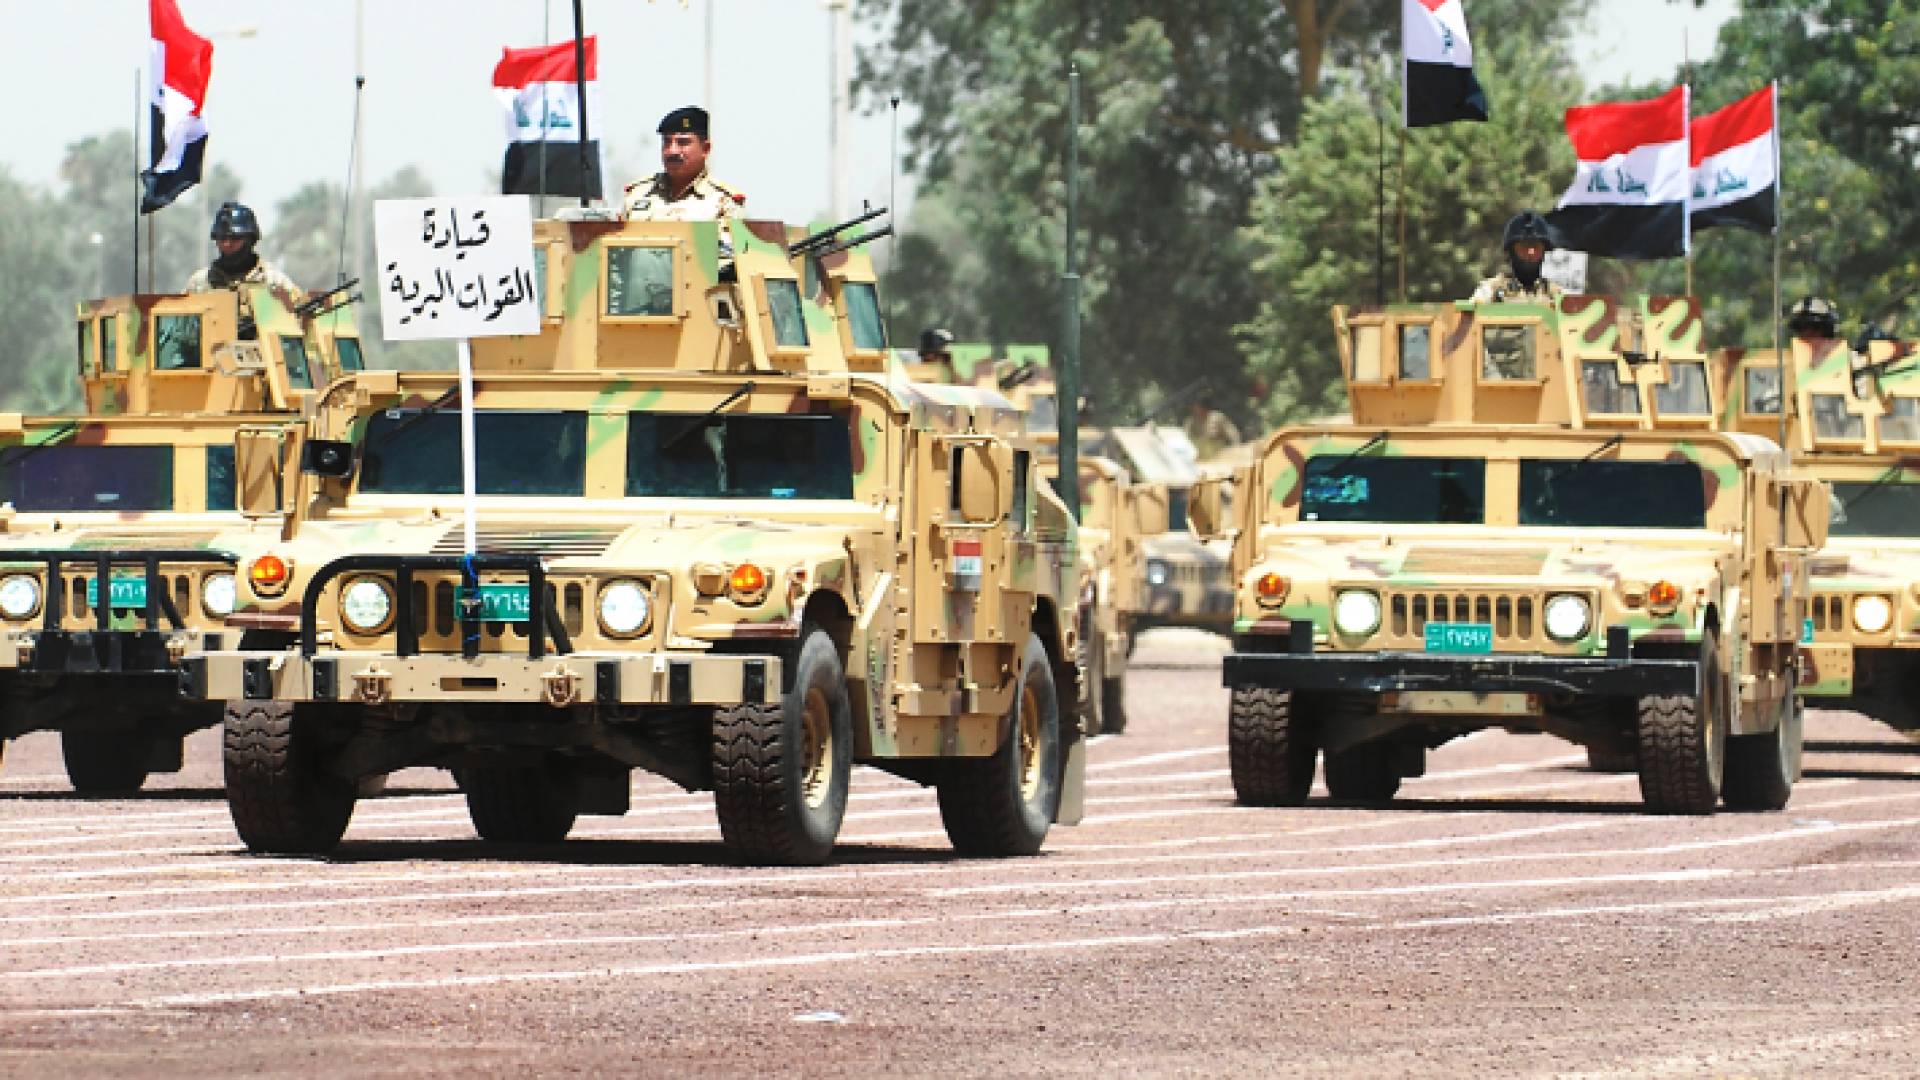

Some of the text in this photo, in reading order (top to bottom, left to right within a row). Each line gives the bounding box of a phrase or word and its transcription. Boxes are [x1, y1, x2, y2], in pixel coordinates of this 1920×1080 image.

[422, 207, 491, 260] قيادة
[386, 265, 534, 325] القوات البرية
